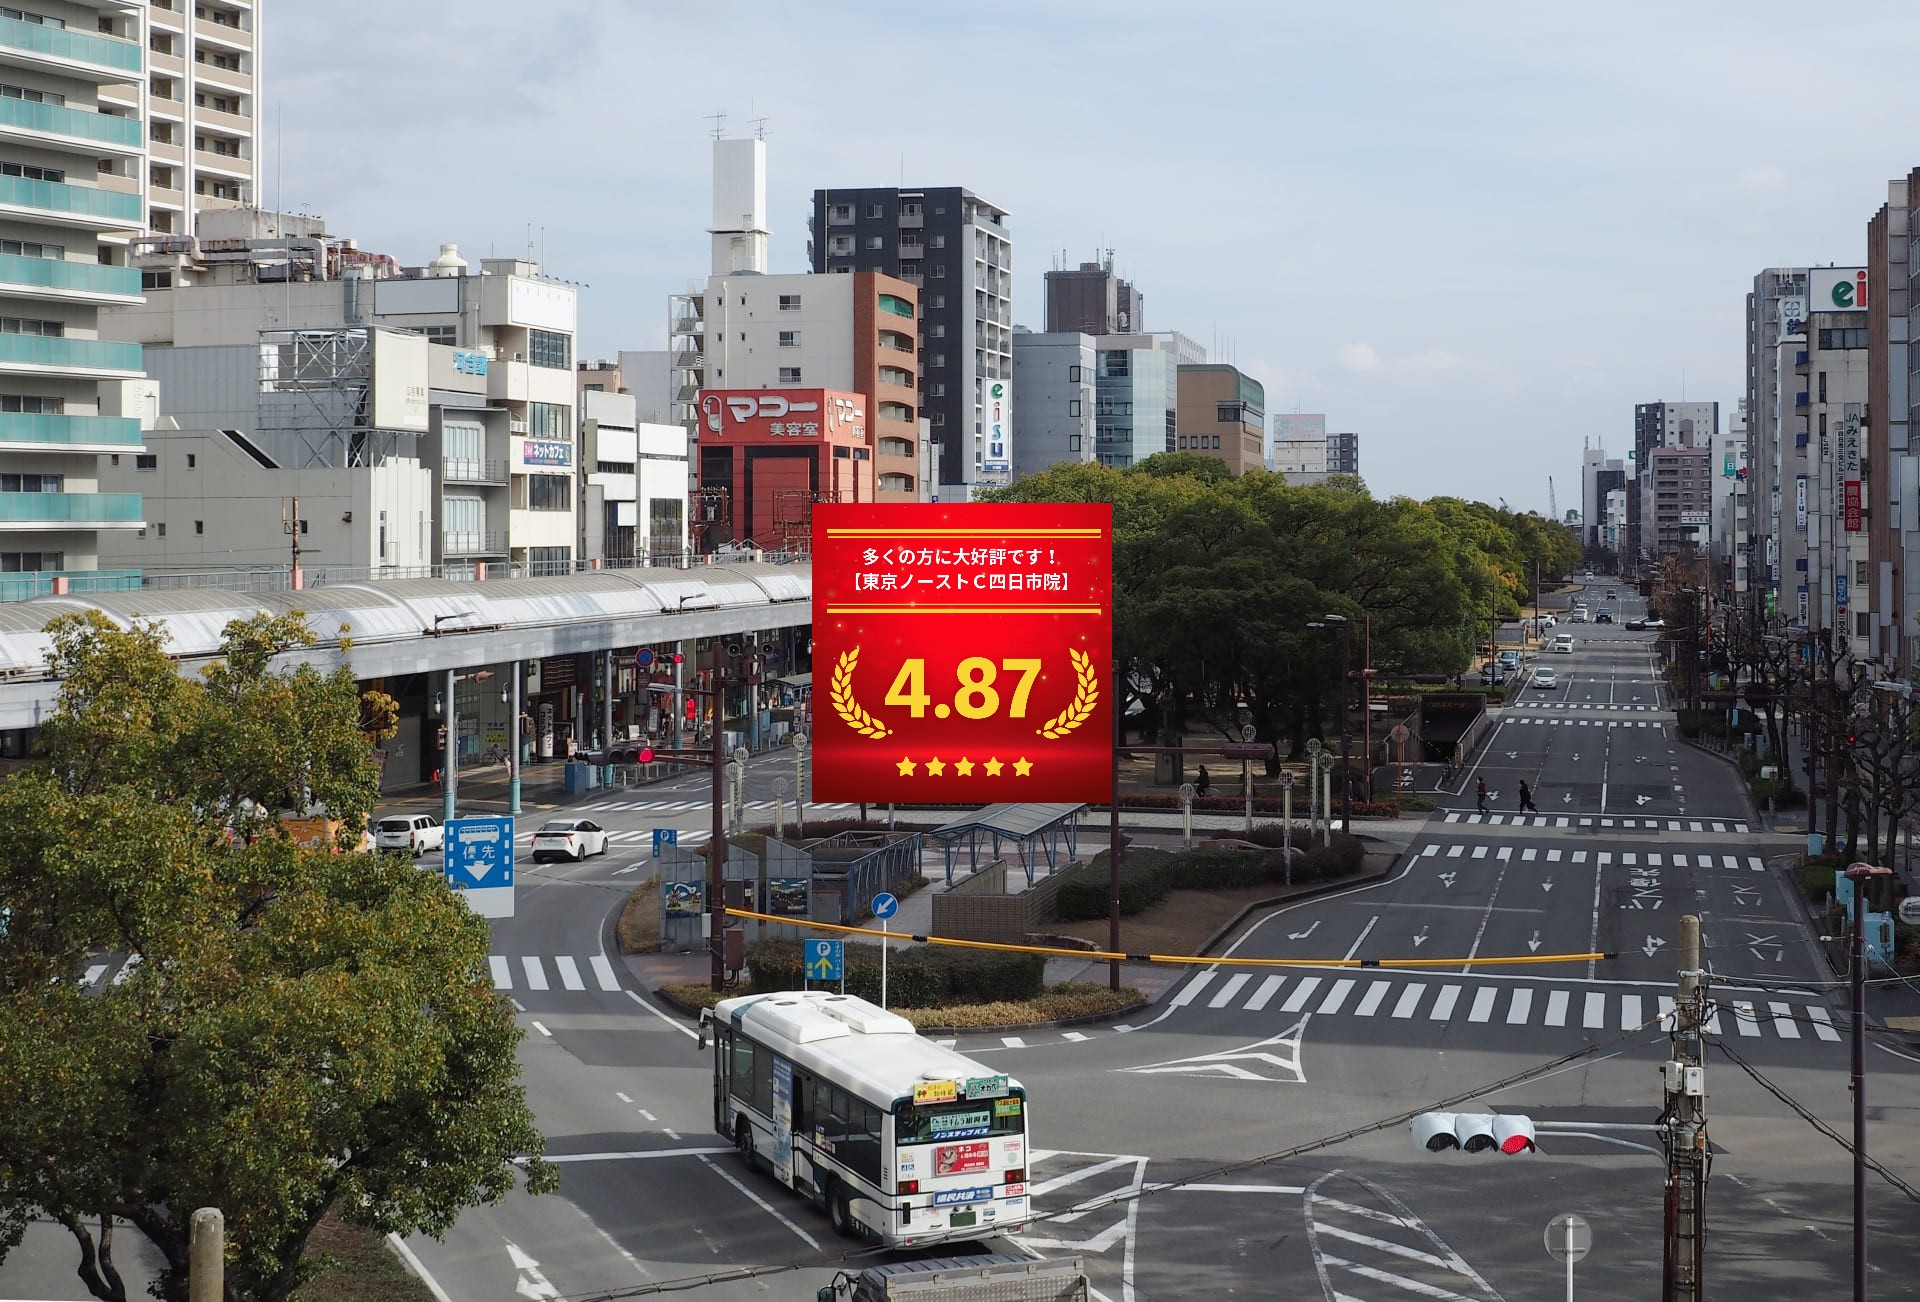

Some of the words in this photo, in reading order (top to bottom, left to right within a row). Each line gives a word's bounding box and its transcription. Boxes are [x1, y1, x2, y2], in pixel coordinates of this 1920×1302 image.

[727, 396, 818, 423] マコー
[836, 399, 863, 426] マコー
[991, 383, 1003, 457] eisu
[770, 421, 819, 437] 美容室
[534, 444, 564, 458] ネットカフェ
[463, 845, 495, 860] 優先
[934, 1127, 988, 1139] ノンステップバス
